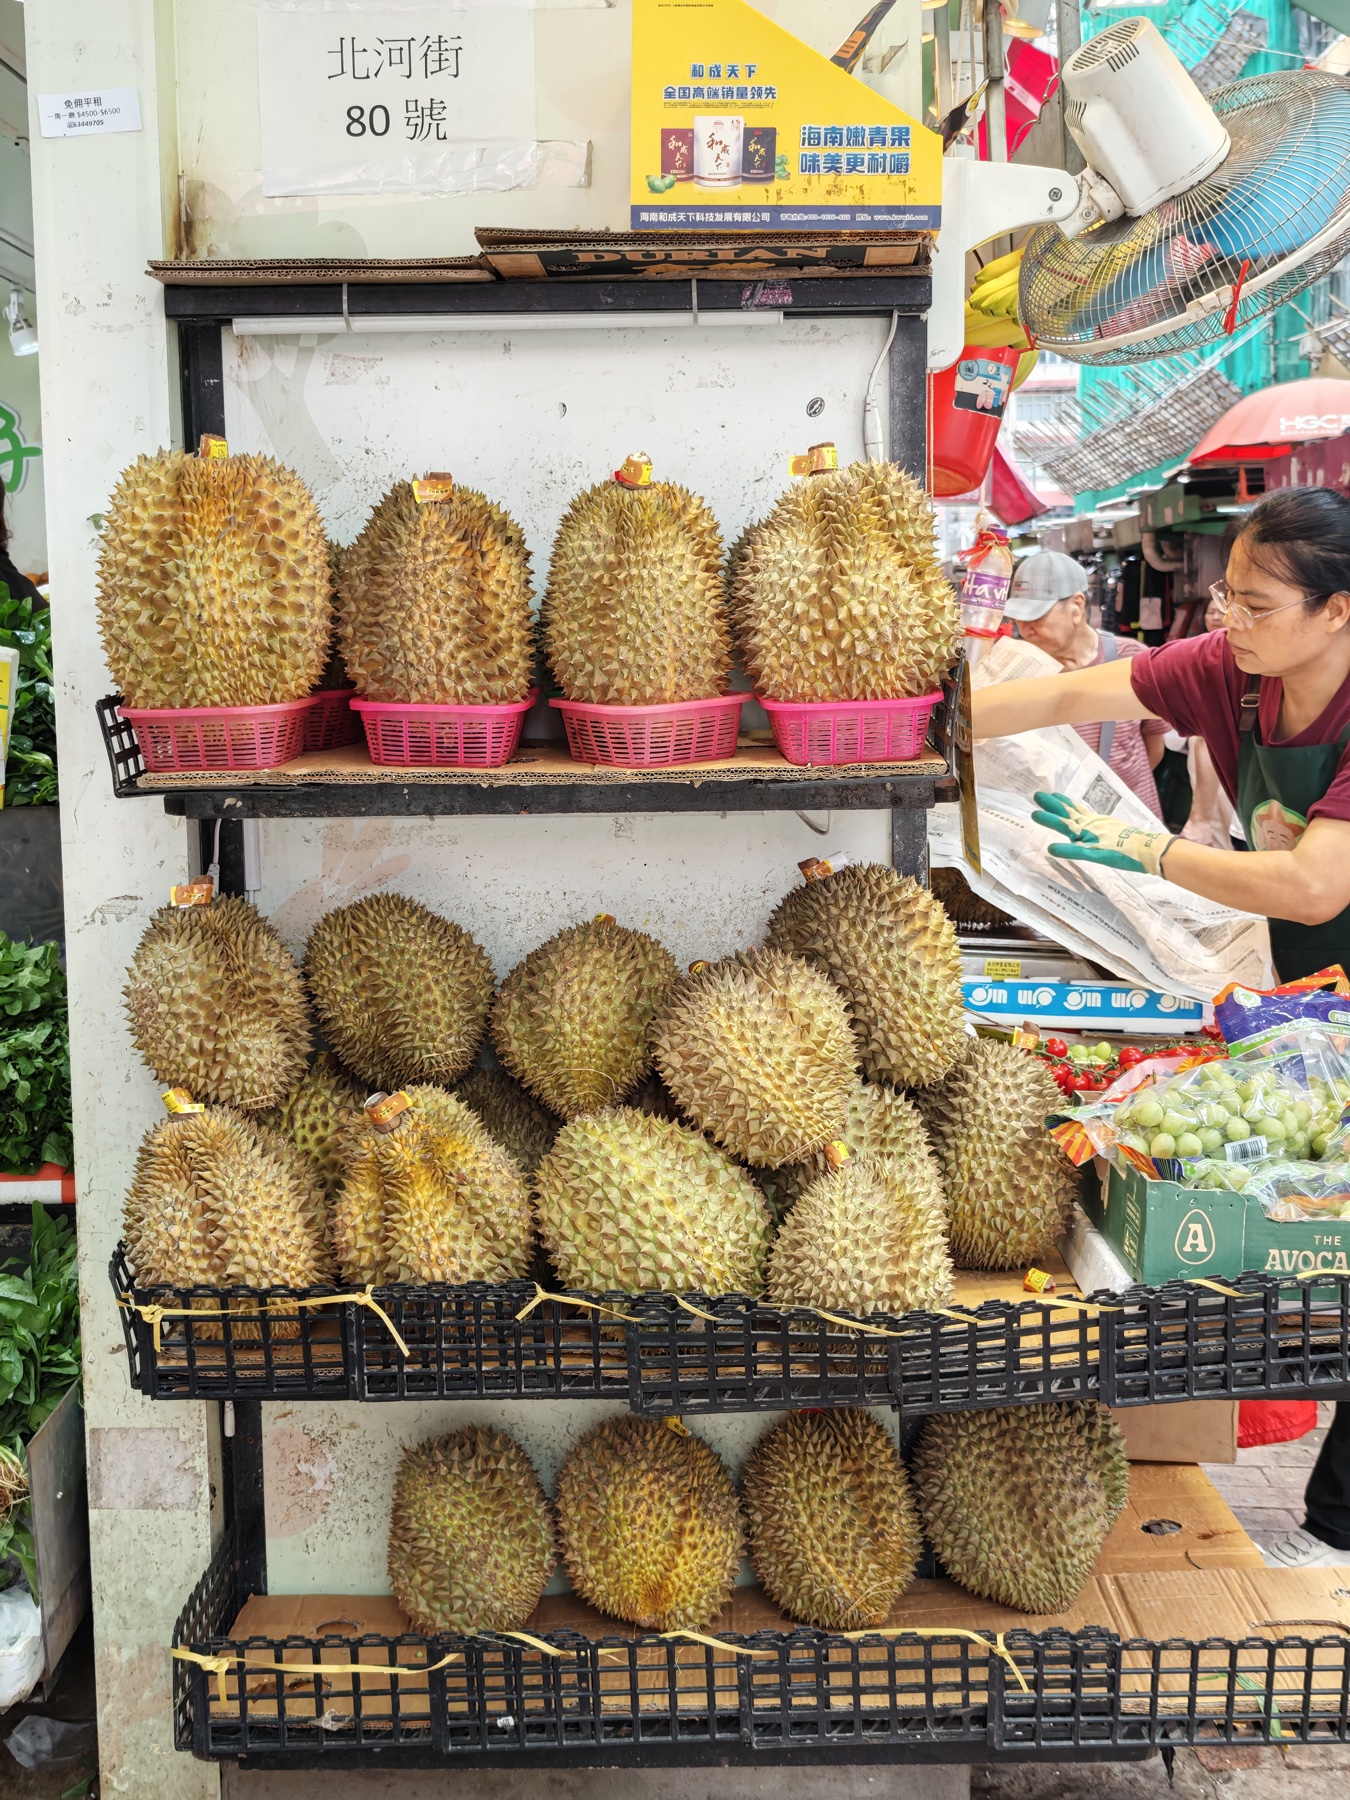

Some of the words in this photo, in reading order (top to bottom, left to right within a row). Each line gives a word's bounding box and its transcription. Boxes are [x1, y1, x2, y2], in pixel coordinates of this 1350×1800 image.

[327, 34, 463, 79] 北河街
[691, 63, 758, 79] 和成天下
[663, 86, 777, 100] 全国高端销量领先
[64, 96, 102, 109] 免佣平租
[346, 104, 390, 137] 80
[404, 97, 447, 141] 號
[801, 126, 910, 147] 海南嫩青果
[800, 152, 910, 174] 味美更耐嚼
[640, 212, 770, 222] 海南和成天下科技发展有限公司
[573, 248, 831, 262] DURIAN
[1280, 415, 1338, 431] HGC
[1182, 1223, 1208, 1252] A
[1313, 1235, 1342, 1246] THE
